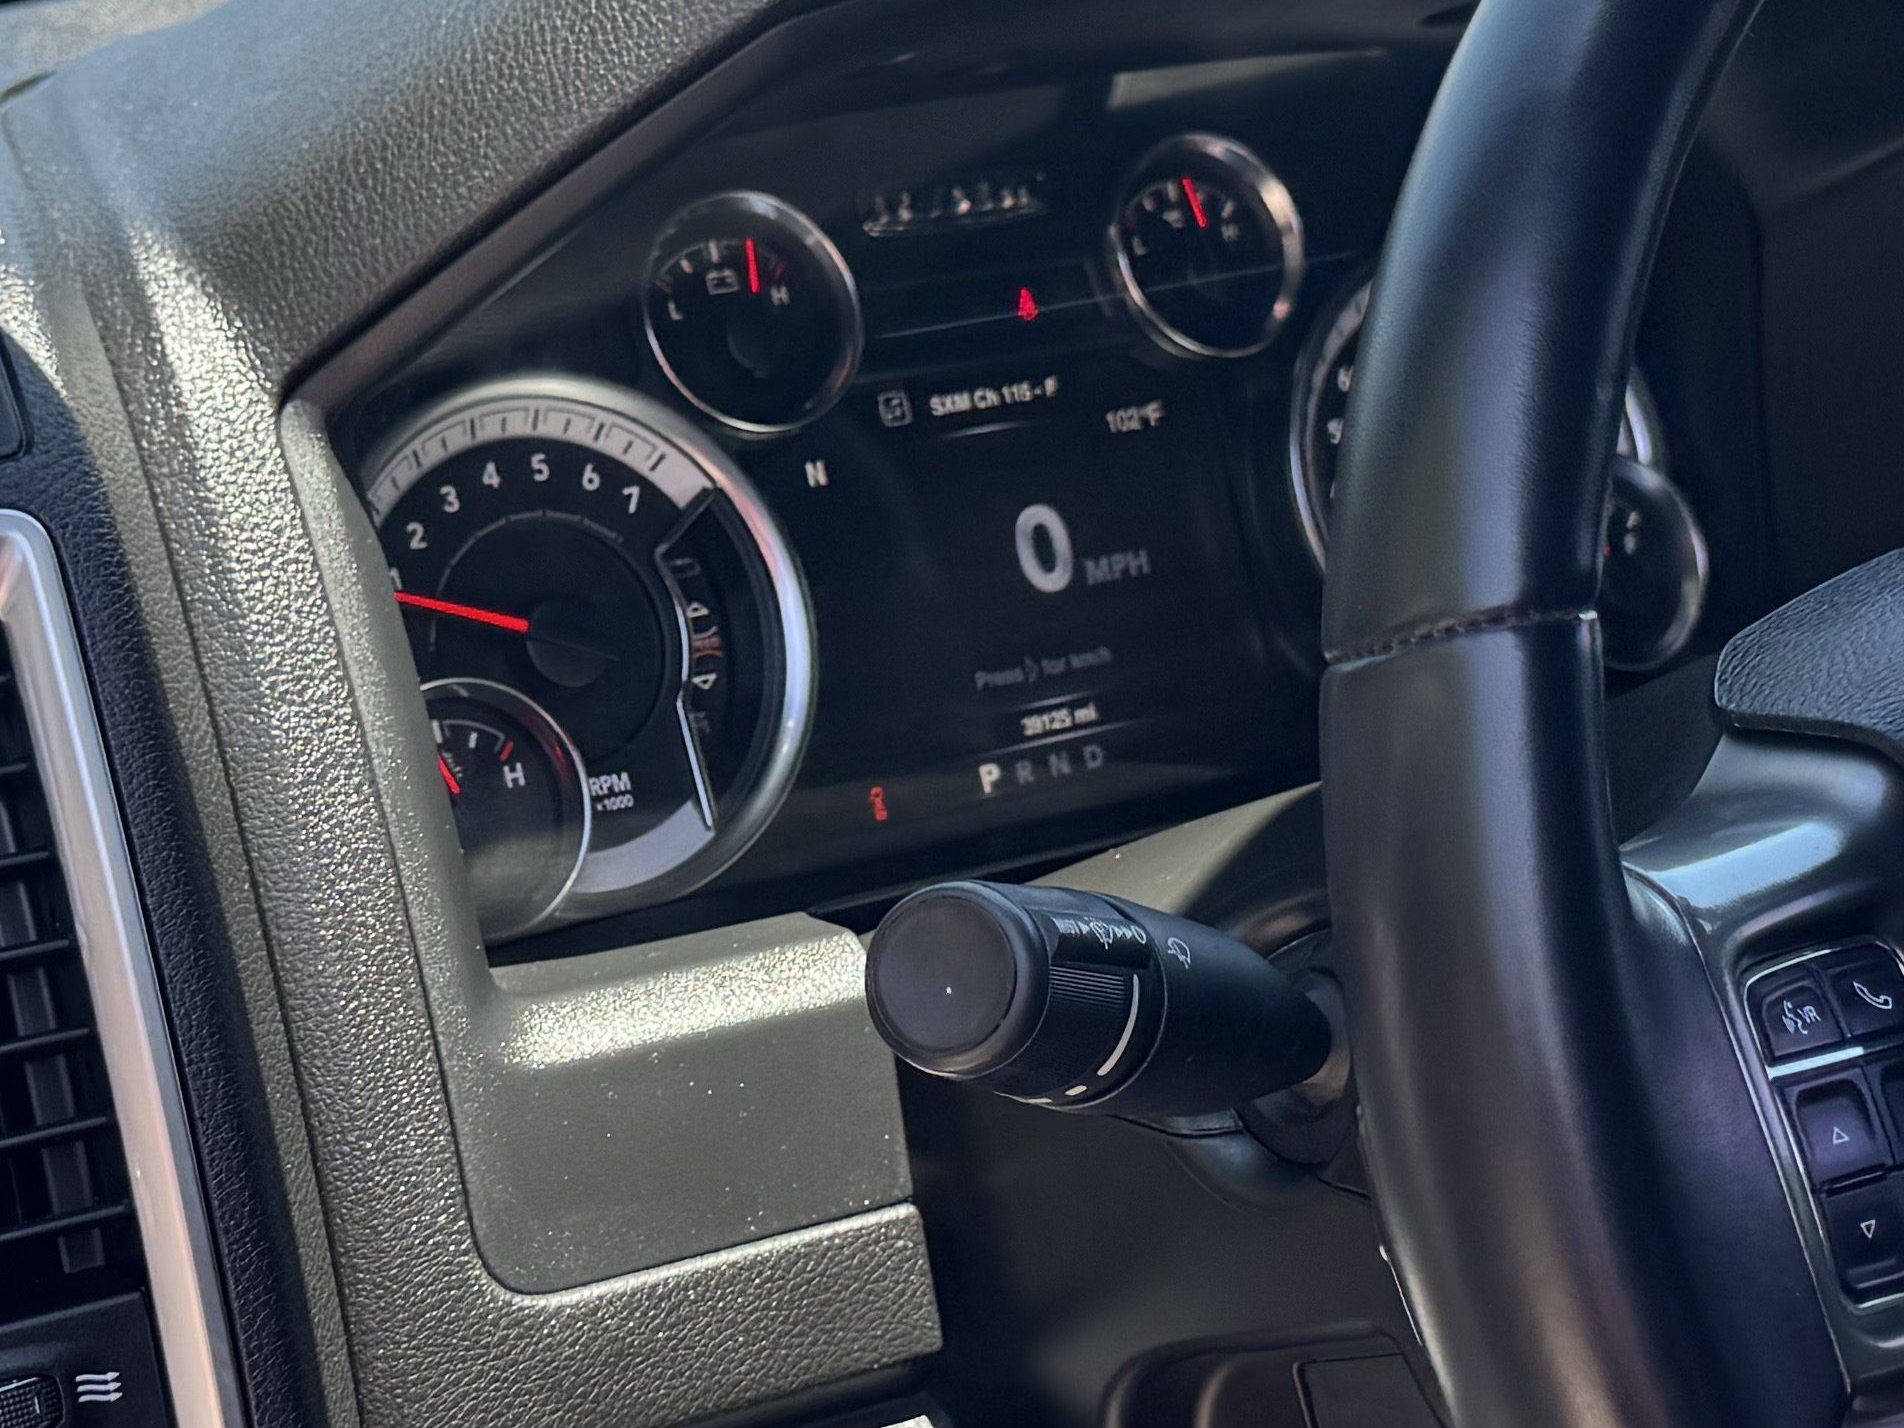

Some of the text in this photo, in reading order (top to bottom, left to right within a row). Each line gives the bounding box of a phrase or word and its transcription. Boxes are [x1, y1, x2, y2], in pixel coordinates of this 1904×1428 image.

[482, 461, 501, 489] 4
[530, 453, 550, 482] 5
[582, 463, 601, 491] 6
[805, 458, 829, 488] N
[439, 484, 461, 513] 3
[621, 484, 641, 514] 7
[407, 522, 428, 551] 2
[1014, 503, 1152, 593] 0 MPH
[503, 762, 526, 788] H
[589, 771, 631, 796] RPM
[978, 763, 1001, 794] P
